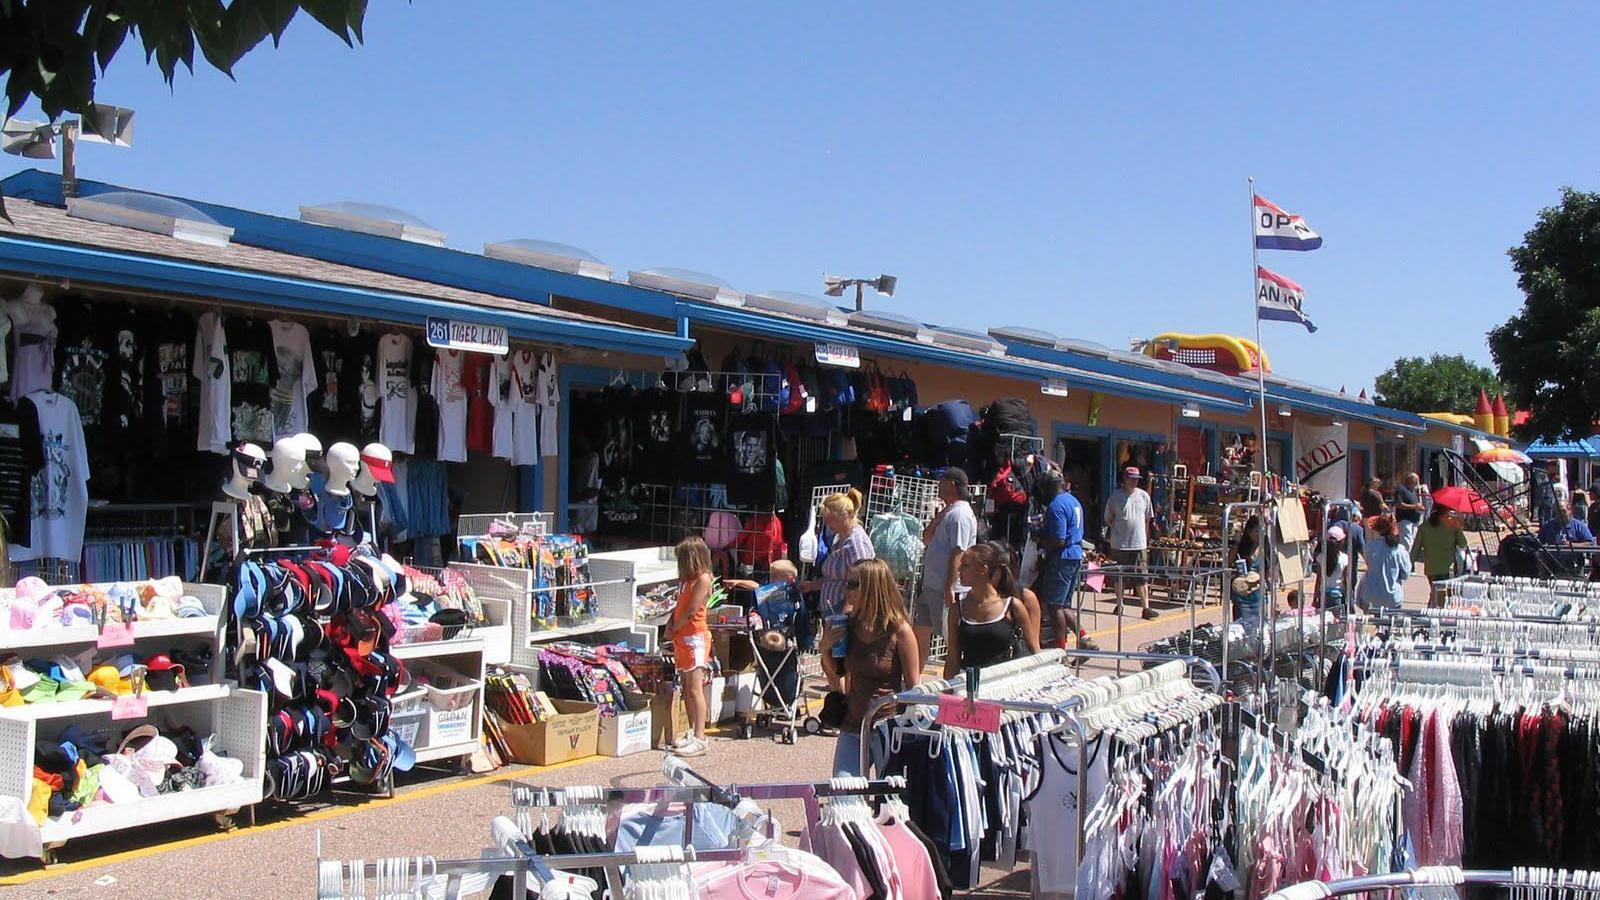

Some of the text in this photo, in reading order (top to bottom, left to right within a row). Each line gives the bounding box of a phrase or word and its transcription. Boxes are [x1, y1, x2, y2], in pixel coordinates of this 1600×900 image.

[1261, 213, 1310, 232] OPN
[430, 322, 503, 346] 261 TIGER LADY
